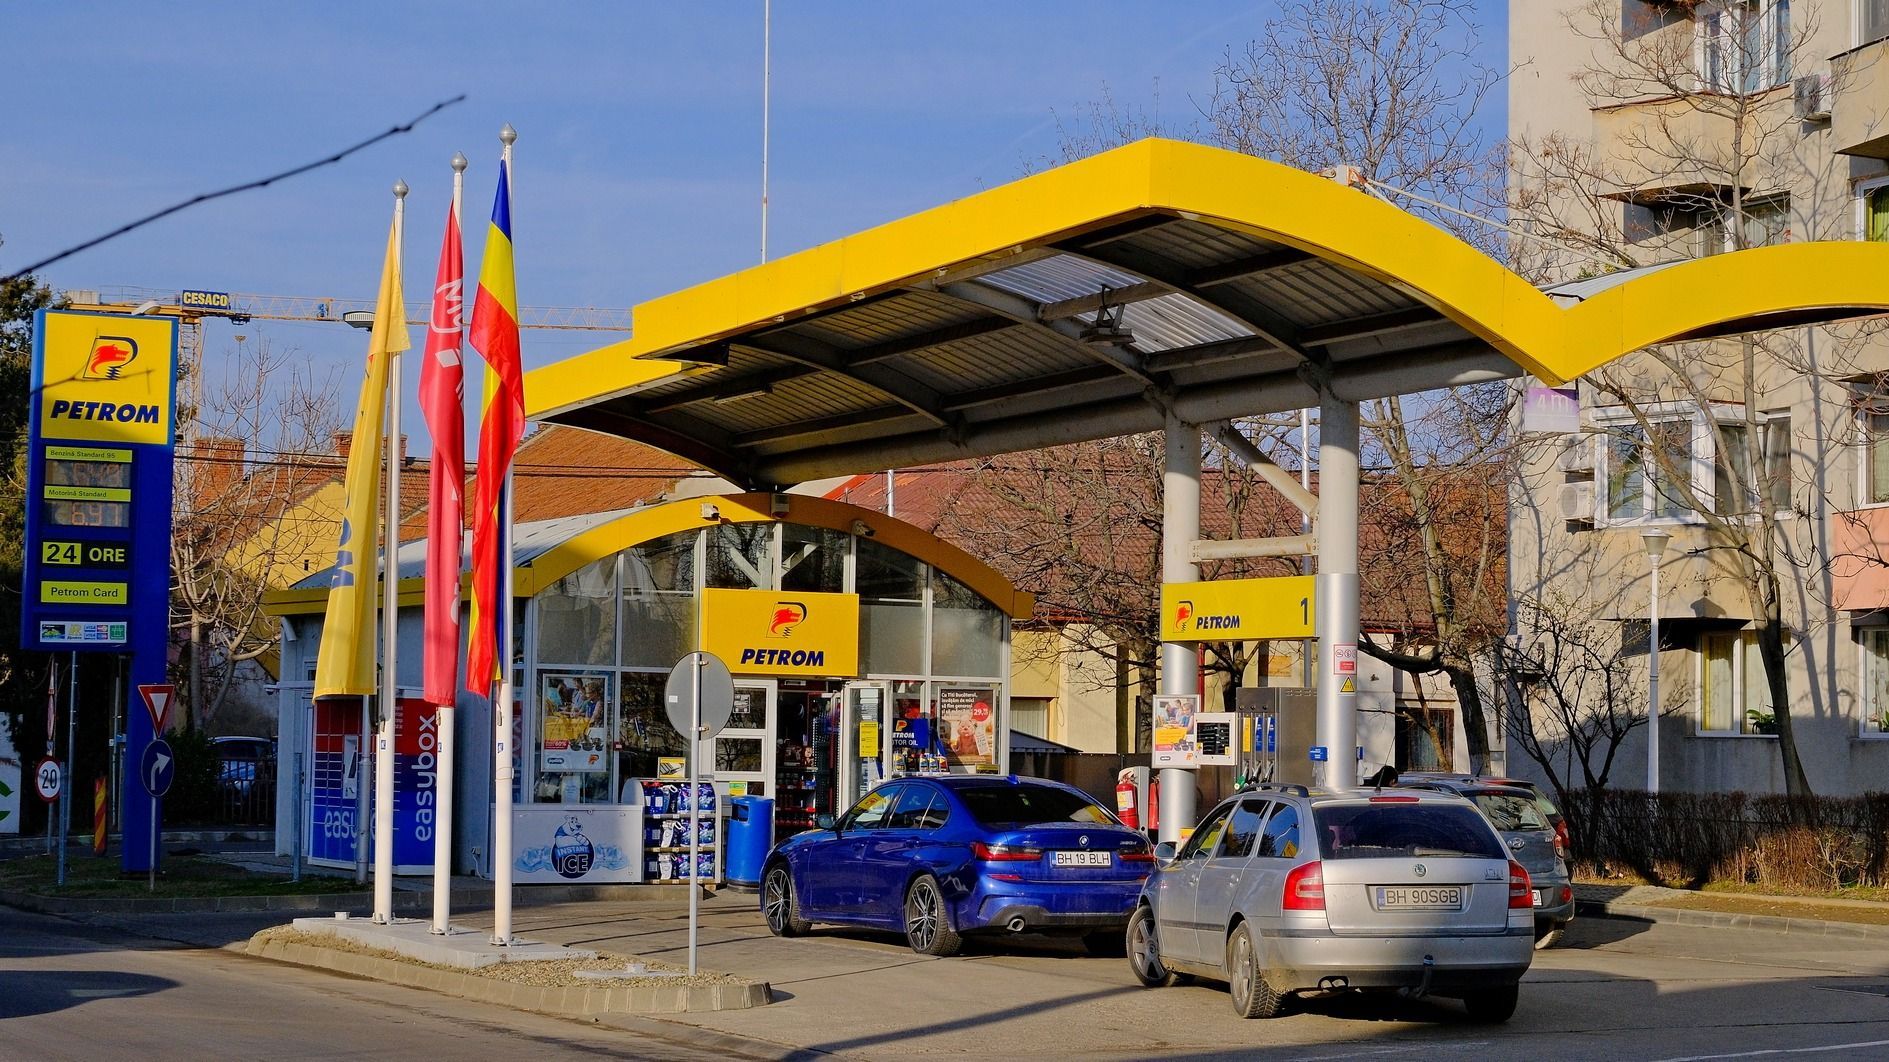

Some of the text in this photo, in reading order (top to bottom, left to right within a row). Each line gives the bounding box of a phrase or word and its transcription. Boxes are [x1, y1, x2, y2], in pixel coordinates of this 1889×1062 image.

[183, 292, 228, 306] CESACO
[51, 400, 159, 424] PETROM
[78, 490, 107, 498] Standard
[46, 543, 125, 563] 24 ORE
[50, 587, 118, 597] Petrom Card
[1300, 597, 1308, 625] 1
[1196, 615, 1240, 629] PETROM
[740, 648, 824, 667] PETROM
[42, 769, 57, 789] 20
[411, 714, 436, 842] easybox
[557, 846, 589, 856] INSTANT
[1057, 853, 1110, 864] BH 19 BLH
[558, 854, 589, 873] ICE
[1386, 890, 1459, 904] BH 90SGB
